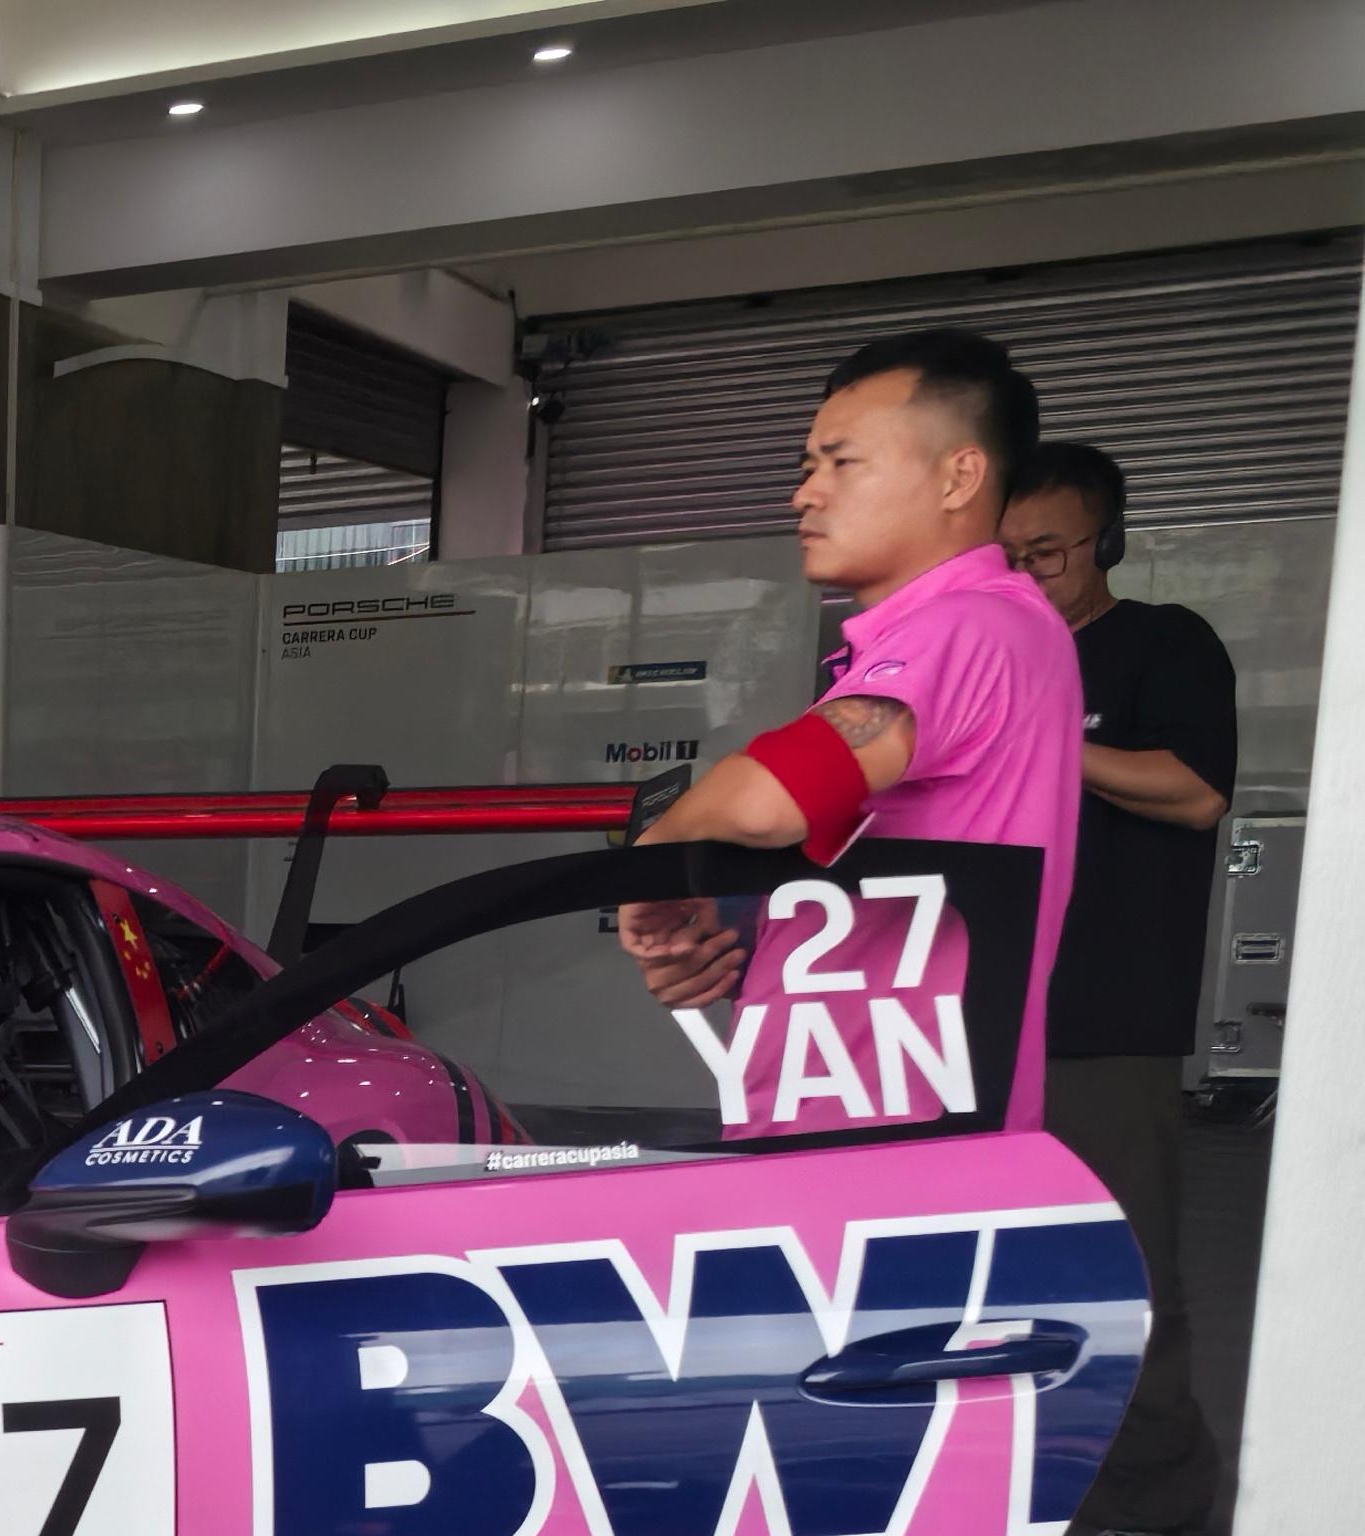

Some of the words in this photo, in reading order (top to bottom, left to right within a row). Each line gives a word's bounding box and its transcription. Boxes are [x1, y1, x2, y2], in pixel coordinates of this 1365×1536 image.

[283, 593, 455, 619] PORSCHE
[282, 629, 345, 645] CARRERA
[349, 627, 378, 641] CUP
[281, 646, 312, 660] ASIA
[605, 740, 672, 763] Mobil
[768, 874, 947, 995] 27
[670, 994, 978, 1126] YAN
[92, 1115, 205, 1149] ADA
[85, 1148, 196, 1168] COSMETICS
[485, 1140, 640, 1173] #carreracupasia
